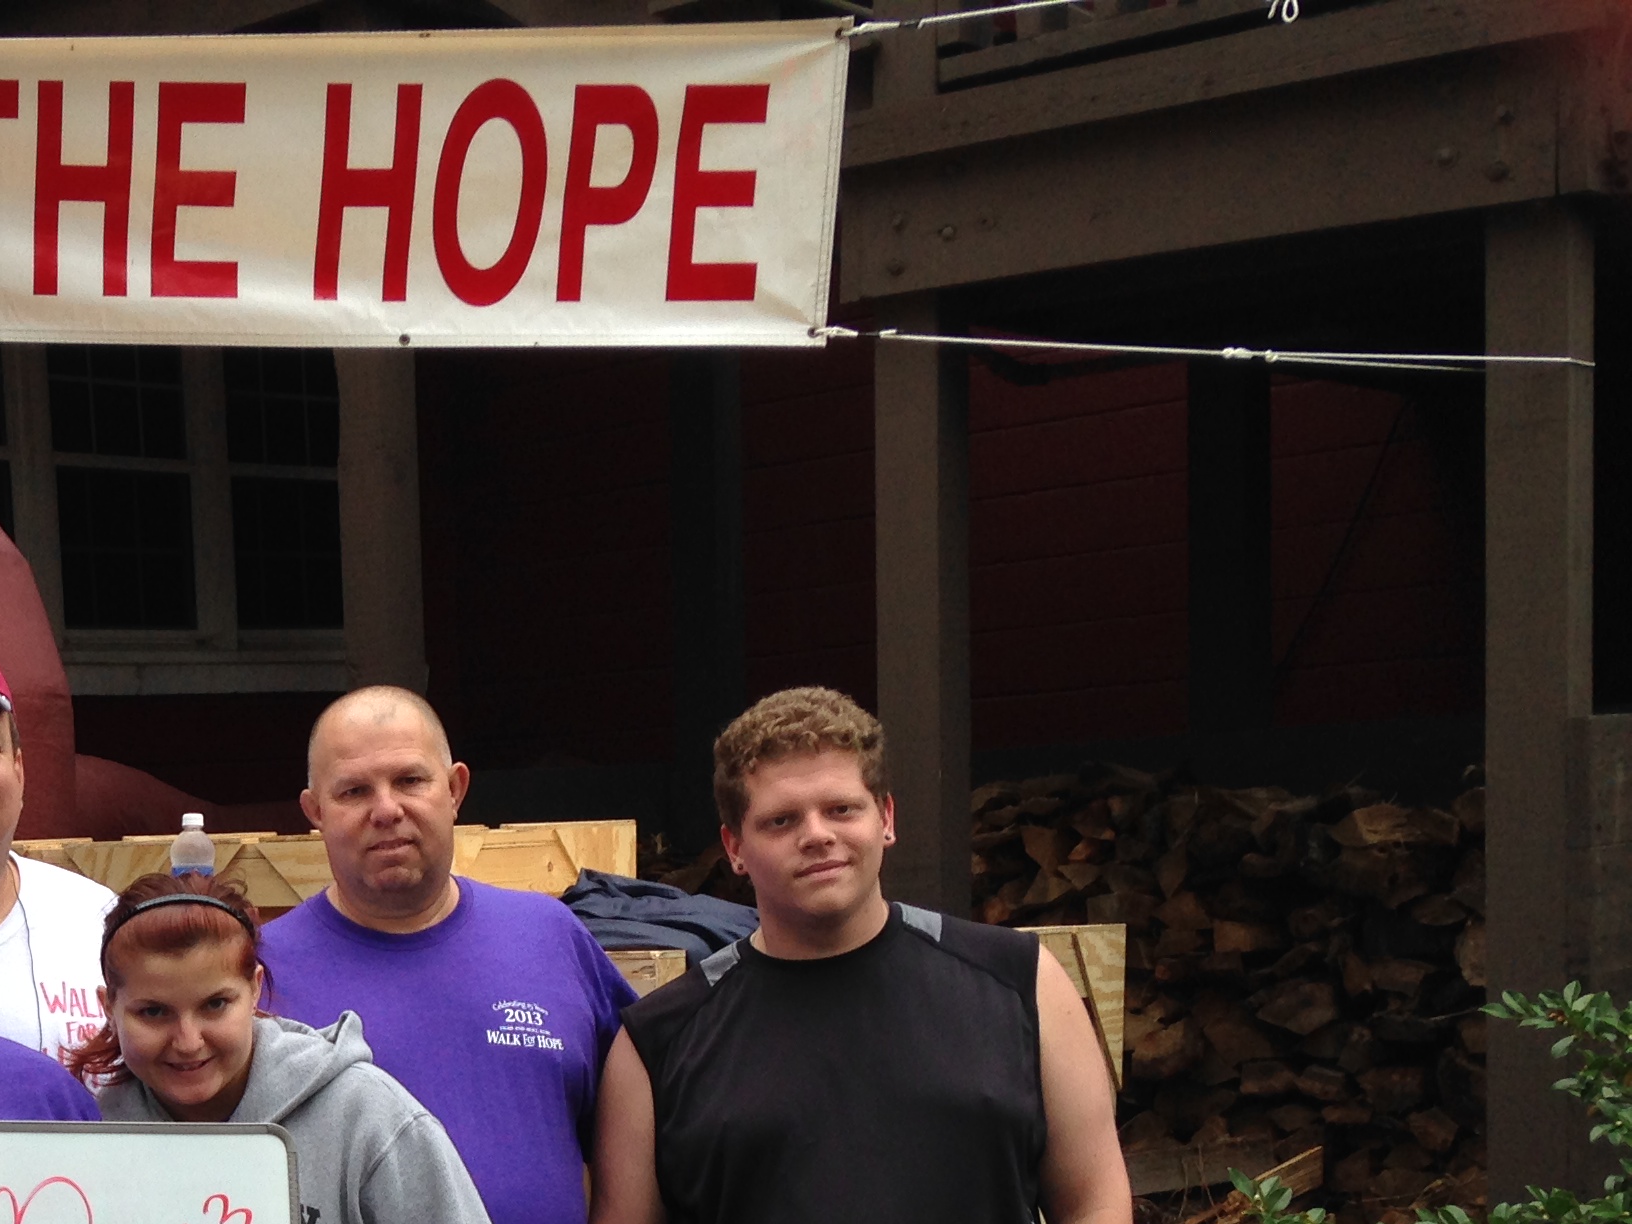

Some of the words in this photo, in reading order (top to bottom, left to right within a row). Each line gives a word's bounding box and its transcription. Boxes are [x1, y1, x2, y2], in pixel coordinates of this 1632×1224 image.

[313, 77, 771, 307] HOPE
[504, 1008, 543, 1026] 2013
[486, 1029, 522, 1046] WALK
[537, 1035, 565, 1051] HOPE
